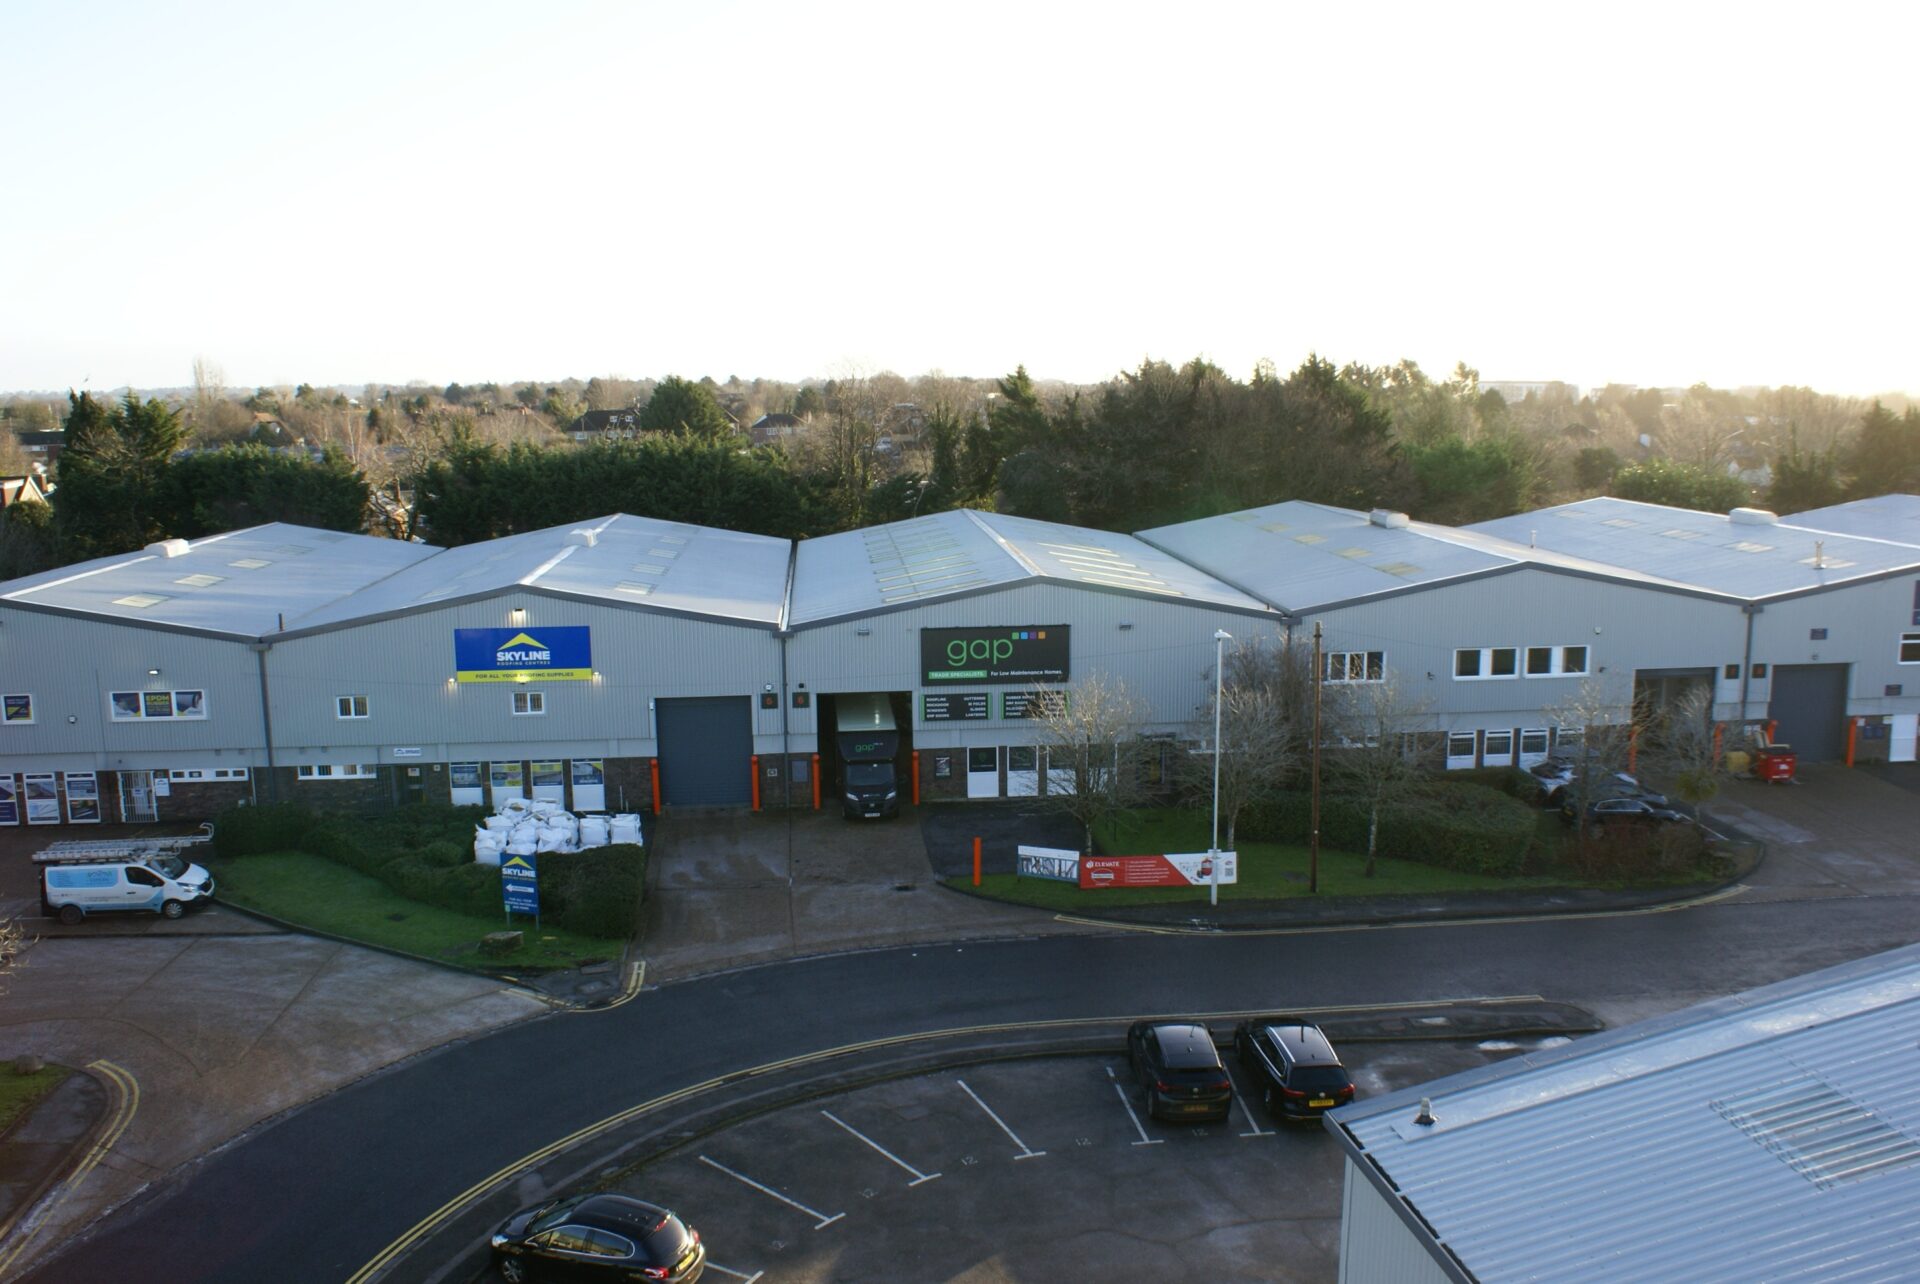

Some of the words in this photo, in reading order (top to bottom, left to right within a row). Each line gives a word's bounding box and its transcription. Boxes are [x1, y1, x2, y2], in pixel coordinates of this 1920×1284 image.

[496, 650, 551, 661] SKYLINE
[947, 638, 1013, 666] gap
[855, 744, 874, 752] gap
[502, 868, 536, 877] SKYLINE
[961, 1156, 978, 1165] 12
